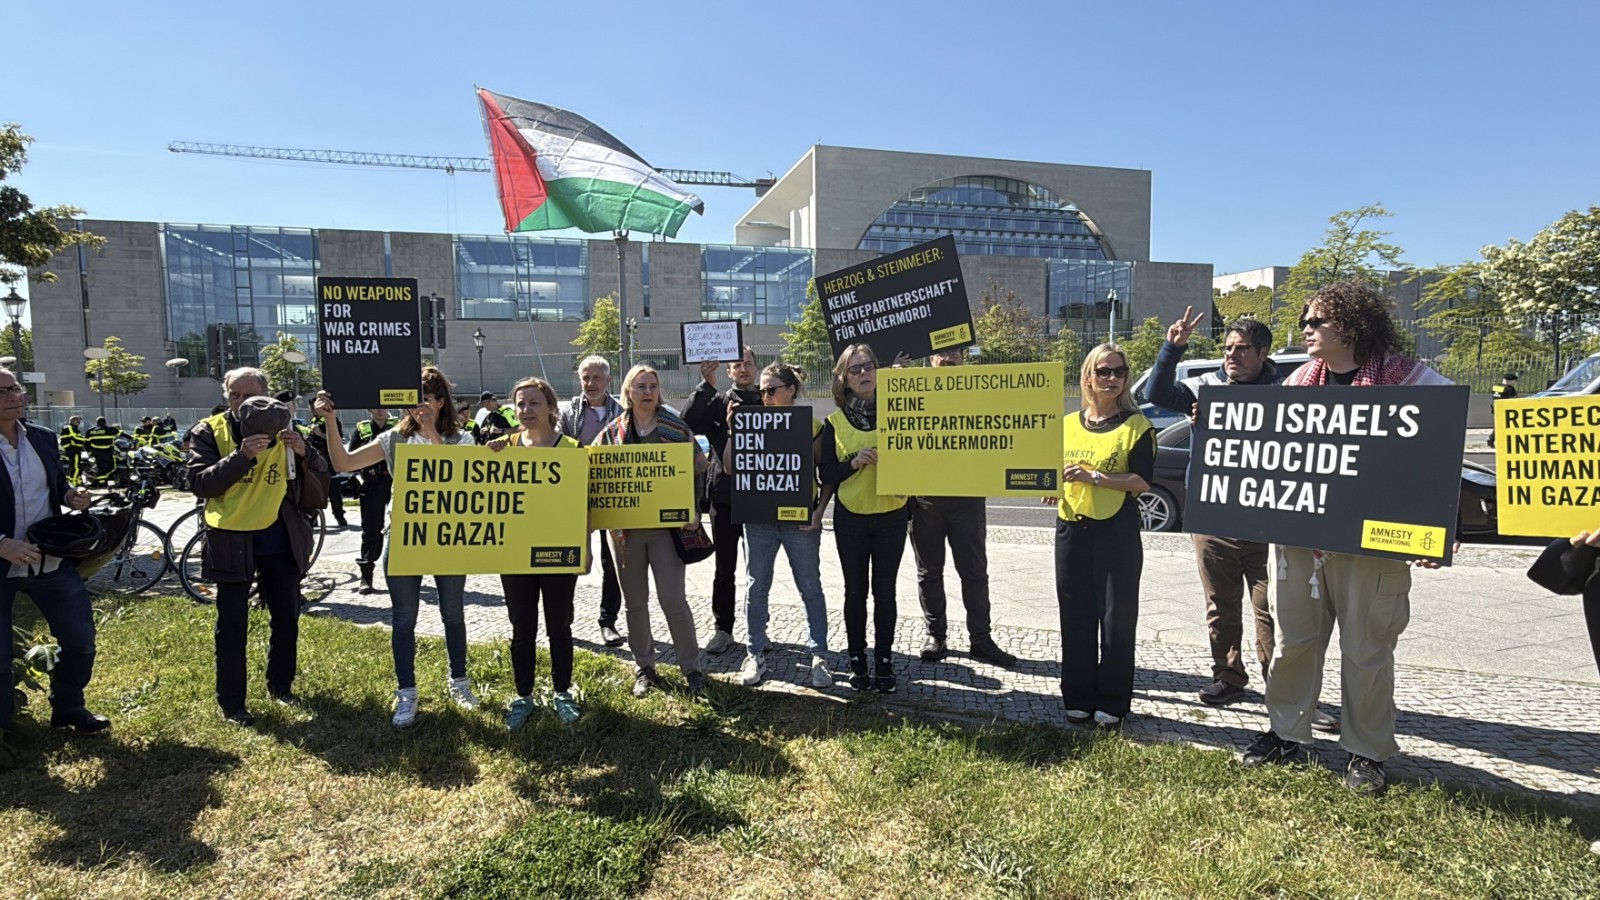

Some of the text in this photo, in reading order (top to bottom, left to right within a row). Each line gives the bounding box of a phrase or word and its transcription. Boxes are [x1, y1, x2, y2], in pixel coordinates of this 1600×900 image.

[823, 247, 945, 295] HERZOG & STEINMEIER:
[323, 286, 412, 301] NO WEAPONS
[827, 290, 858, 311] KEINE
[324, 304, 352, 318] FOR
[324, 322, 411, 336] WAR CRIMES
[835, 304, 932, 342] FÜR VÖLKERMORD!
[326, 340, 380, 354] IN GAZA
[887, 373, 1050, 393] ISRAEL & DEUTSCHLAND:
[887, 397, 925, 412] KEINE
[735, 413, 792, 430] STOPPT
[880, 414, 1056, 434] „WERTEPARTNERSCHAFT“
[1208, 402, 1420, 437] END ISRAEL’S
[1505, 405, 1600, 428] RESPEC
[735, 433, 764, 450] DEN
[887, 433, 1013, 450] FÜR VÖLKERMORD!
[1506, 433, 1600, 454] INTERN
[588, 451, 667, 464] NTERNATIONALE
[735, 453, 801, 471] GENOZID
[1064, 450, 1096, 459] MNESTY
[1204, 438, 1360, 476] GENOCIDE
[406, 458, 561, 484] END ISRAEL’S
[589, 467, 633, 479] ERICHTE
[636, 465, 676, 478] ACHTEN
[589, 481, 653, 494] AFTBEFEHLE
[736, 474, 799, 491] IN GAZA!
[404, 490, 525, 515] GENOCIDE
[1200, 474, 1328, 514] IN GAZA!
[1508, 486, 1531, 505] IN
[403, 522, 505, 546] IN GAZA!
[1371, 527, 1413, 539] AMNESTY
[1369, 537, 1411, 547] INTERNATIONAL
